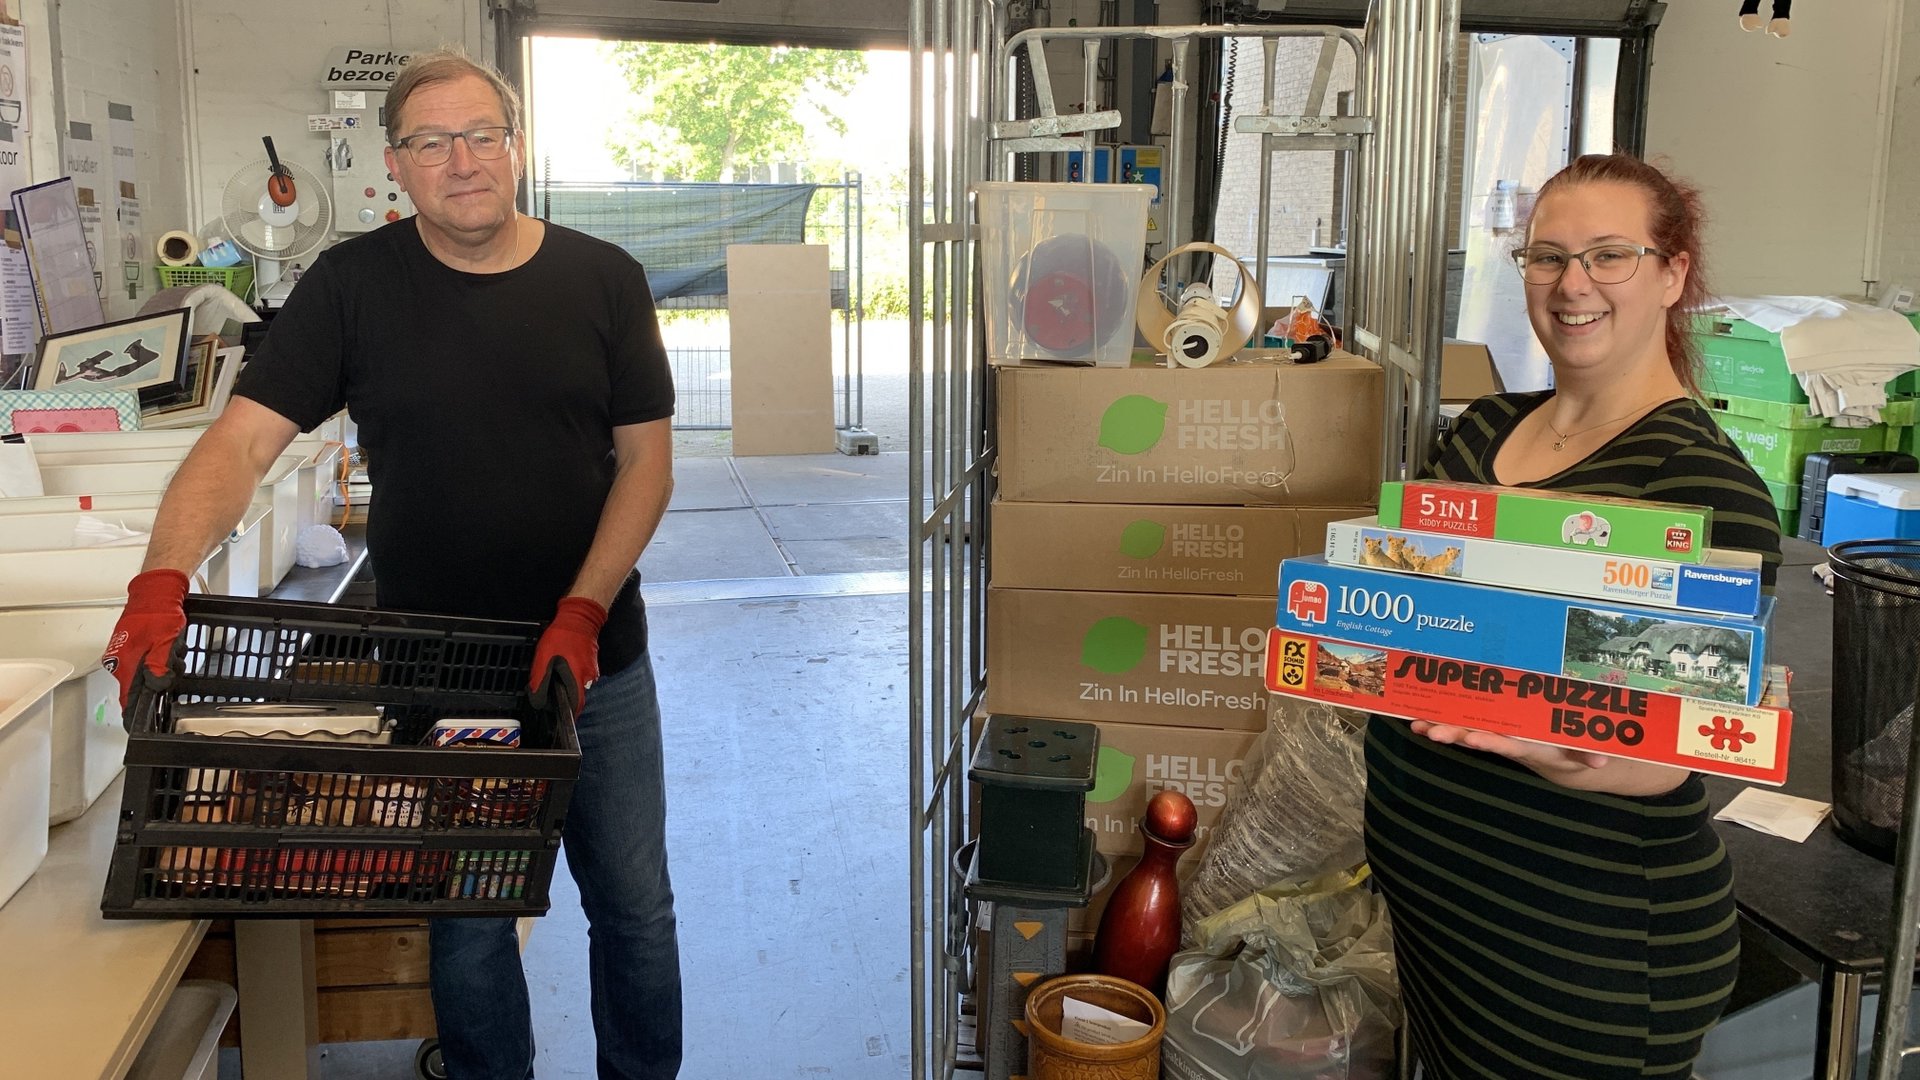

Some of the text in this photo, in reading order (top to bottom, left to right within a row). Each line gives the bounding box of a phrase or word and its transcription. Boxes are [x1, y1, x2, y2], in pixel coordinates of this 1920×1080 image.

[327, 67, 397, 81] bezoe
[0, 151, 18, 165] oor
[67, 154, 98, 174] Huisdier
[1178, 399, 1286, 425] HELLO
[1177, 425, 1286, 450] FRESH
[1746, 431, 1779, 450] weg!
[1096, 465, 1286, 485] Zin In HelloFresh
[1420, 493, 1478, 521] 5 IN 1
[1172, 523, 1244, 541] HELLO
[1419, 517, 1478, 532] KIDDY PUZZLES
[1172, 541, 1244, 559] FRESH
[1666, 540, 1689, 549] KING
[1118, 566, 1244, 582] Zin In HelloFresh
[1603, 560, 1649, 588] 500
[1684, 569, 1753, 587] Ravensburger
[1602, 584, 1672, 601] Ravensburger Puzzle
[1336, 585, 1475, 634] 1000 puzzle
[1160, 624, 1267, 652] HELLO
[1336, 619, 1393, 637] English Cottage
[1284, 640, 1306, 658] FX
[1160, 649, 1266, 677] FRESH
[1283, 656, 1305, 665] SCHMID
[1394, 655, 1648, 717] SUPER-PUZZLE
[1080, 682, 1266, 711] Zin In HelloFresh
[1551, 707, 1645, 746] 1500
[1146, 754, 1246, 784] HELLO
[1734, 756, 1757, 766] 98412
[1146, 780, 1236, 808] FES
[1105, 814, 1124, 834] In
